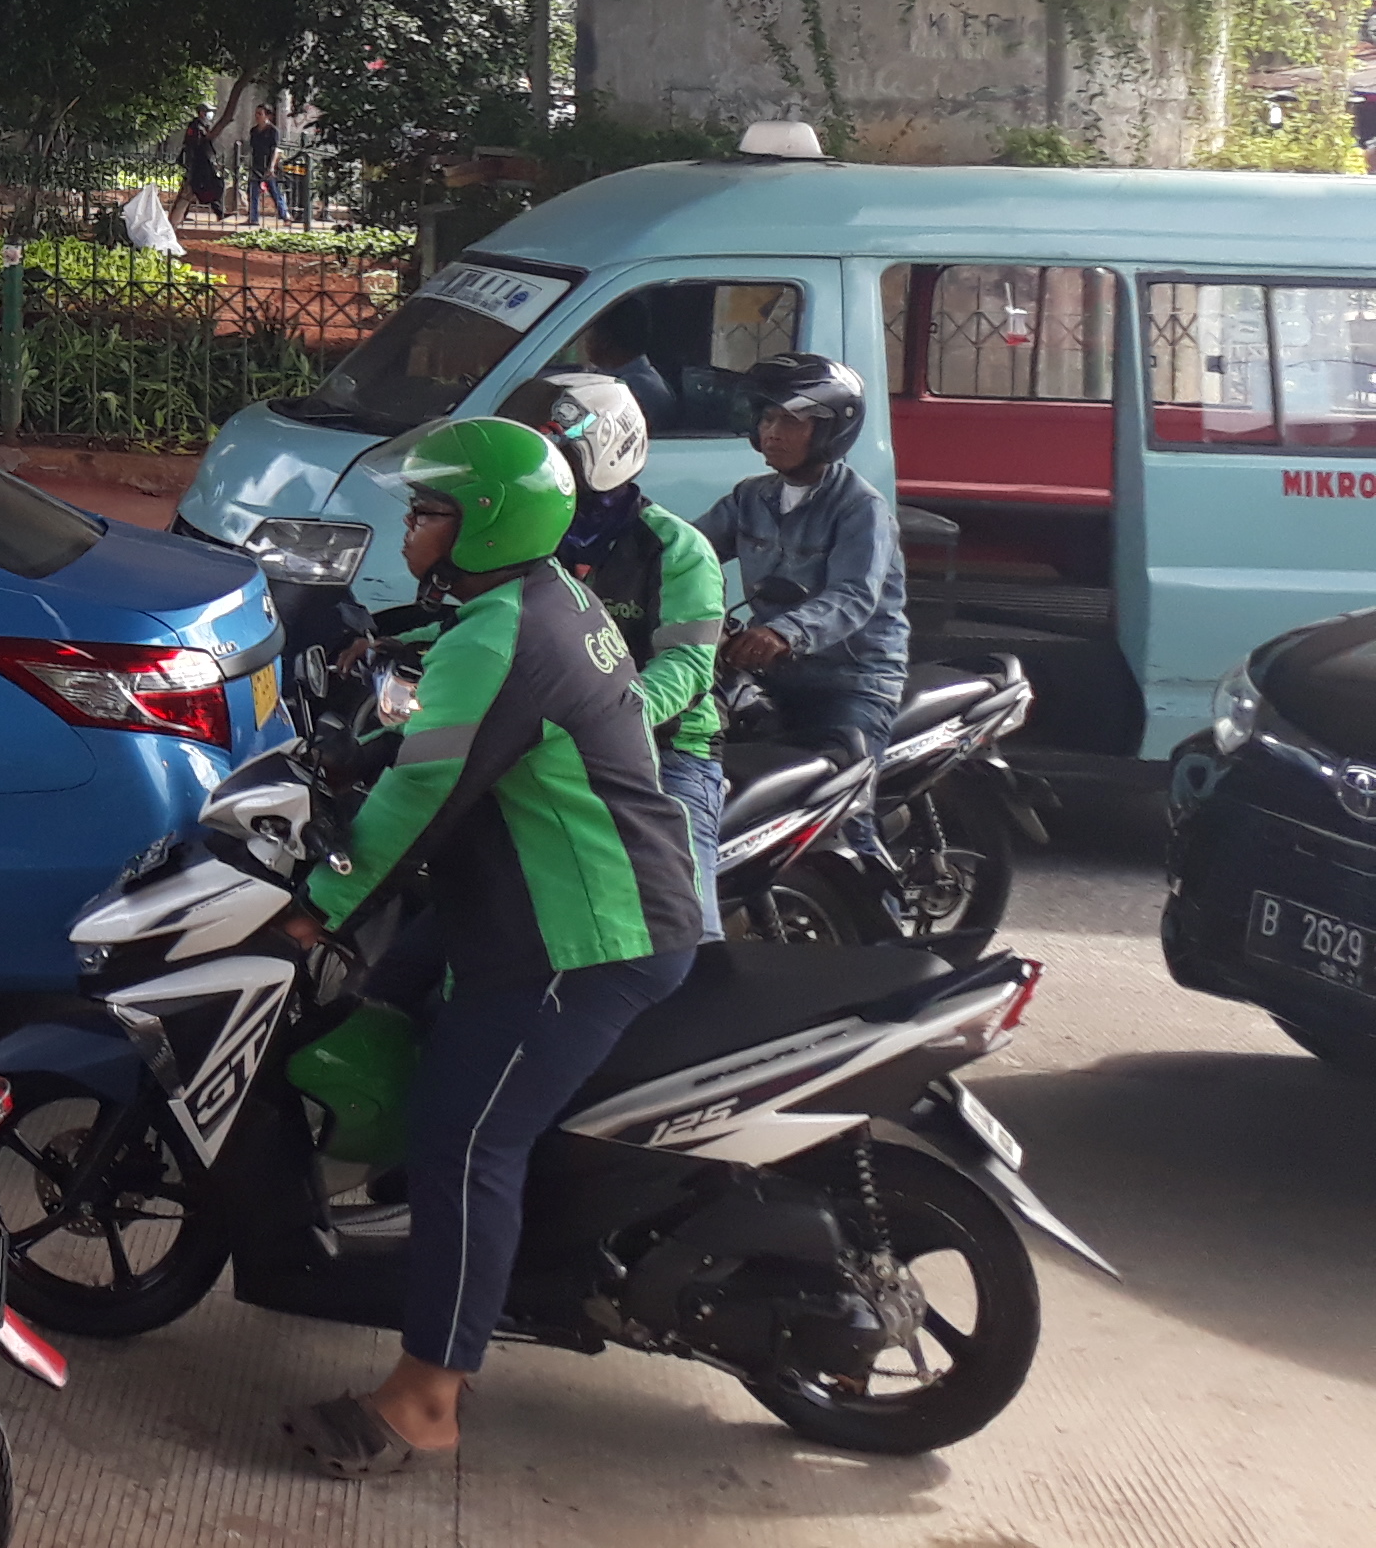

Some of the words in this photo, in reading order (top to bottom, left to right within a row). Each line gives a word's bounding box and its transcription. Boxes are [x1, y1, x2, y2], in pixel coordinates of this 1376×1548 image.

[1281, 470, 1376, 499] MIKRO
[1262, 898, 1281, 937] B
[1302, 913, 1363, 966] 2629
